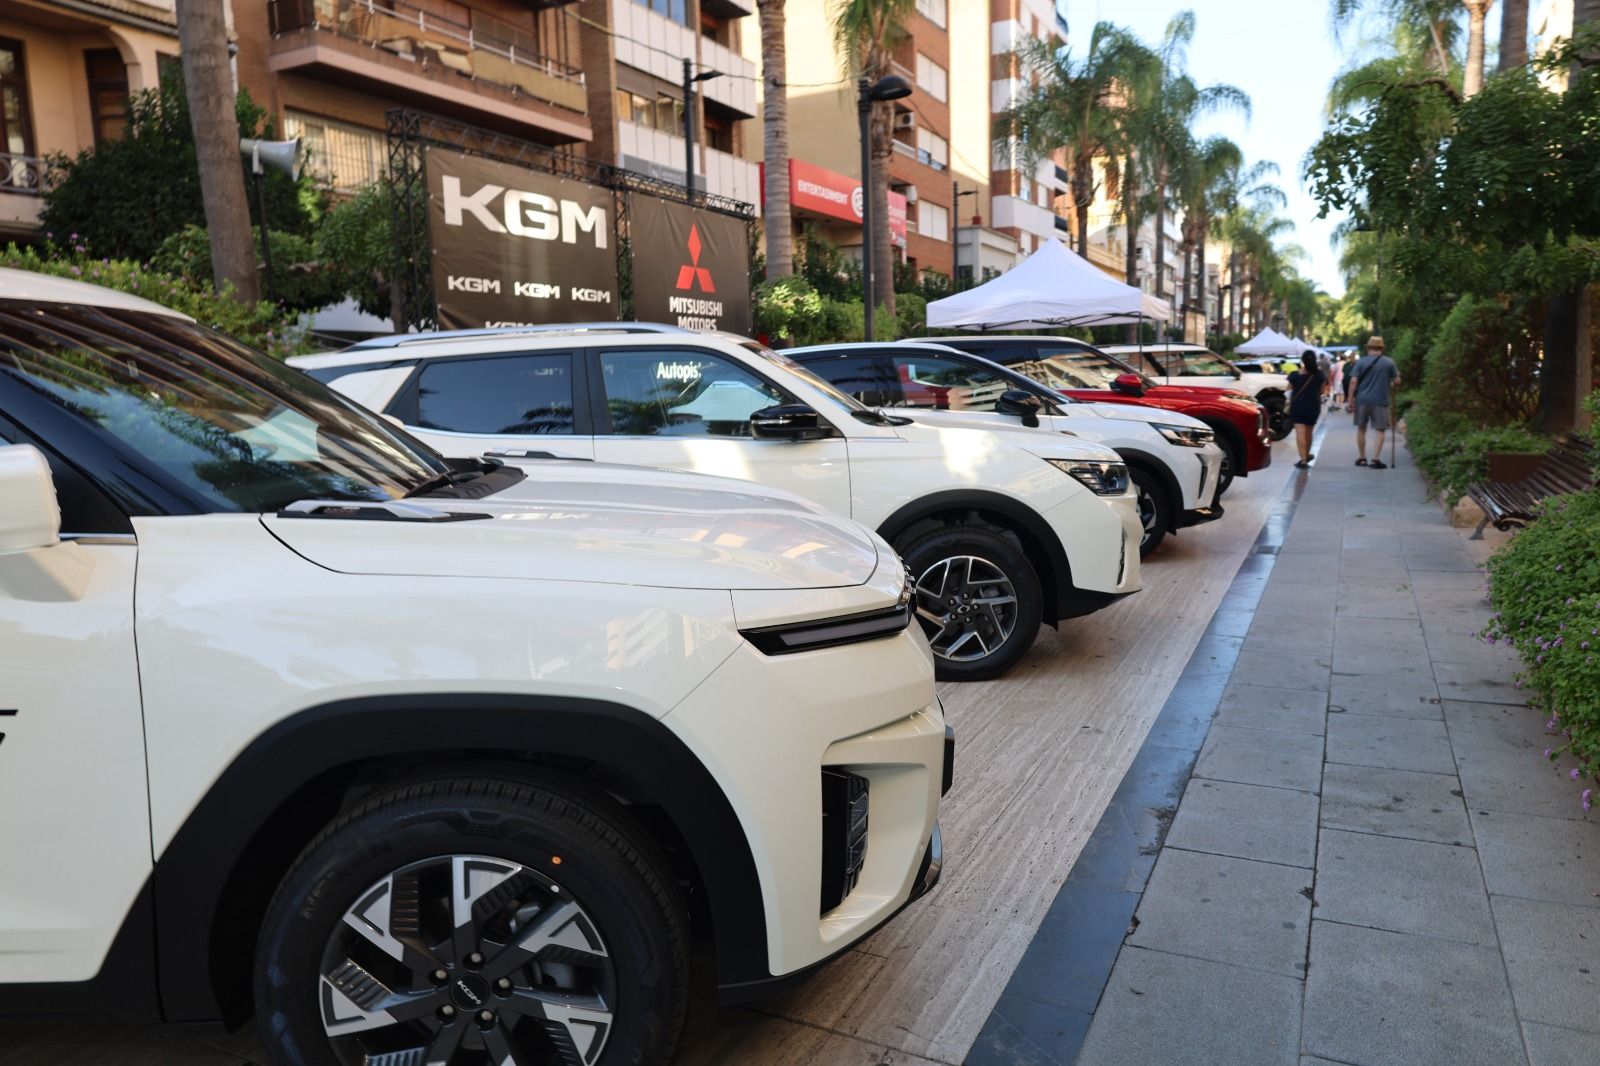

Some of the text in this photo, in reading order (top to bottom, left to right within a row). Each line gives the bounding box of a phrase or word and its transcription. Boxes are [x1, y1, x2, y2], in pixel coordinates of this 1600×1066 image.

[442, 175, 608, 250] KGM
[447, 275, 612, 303] KGM KGM KGM
[669, 296, 723, 317] MITSUBISHI
[677, 315, 718, 332] MOTORS
